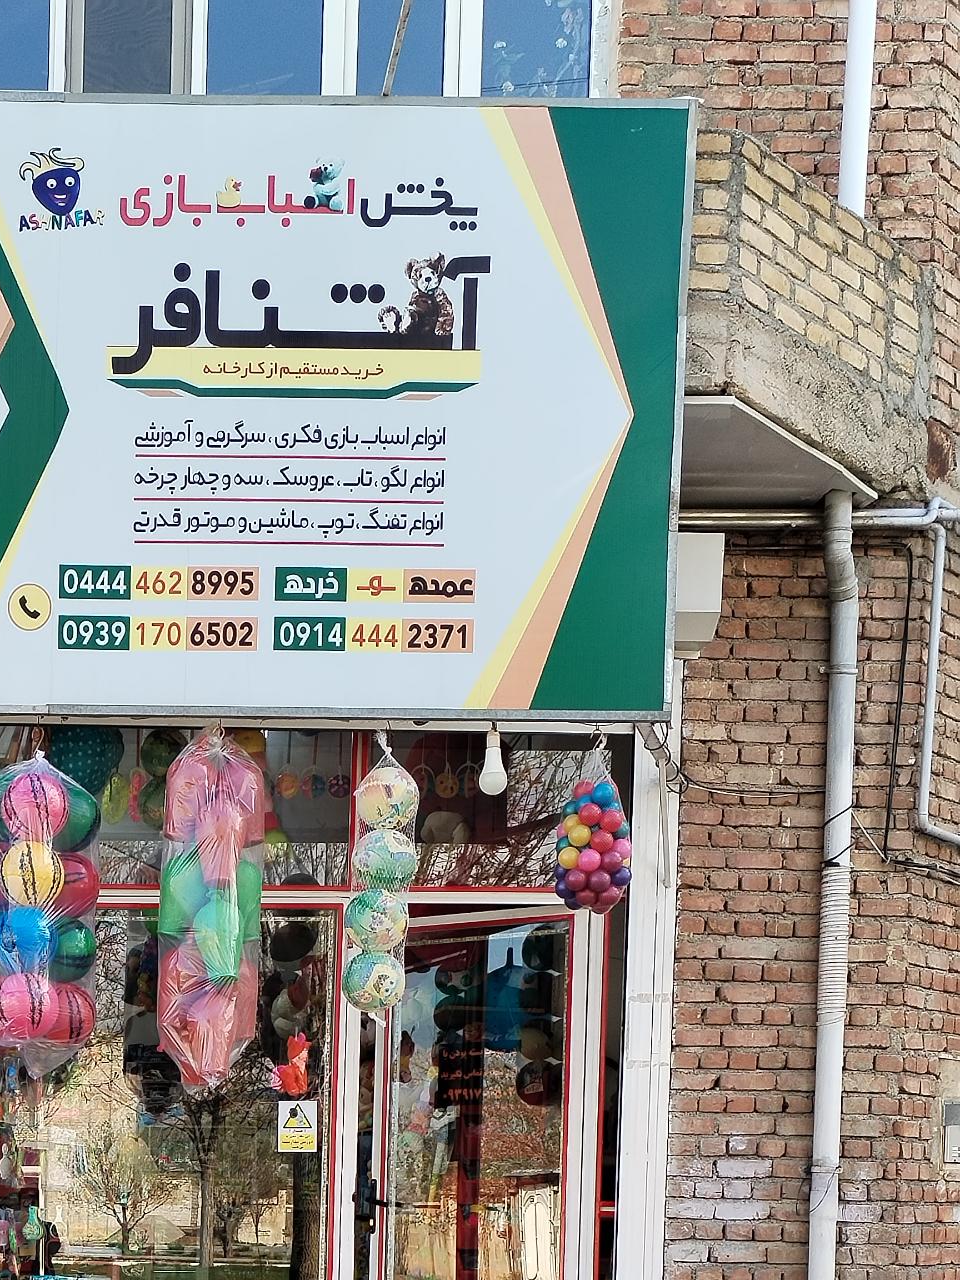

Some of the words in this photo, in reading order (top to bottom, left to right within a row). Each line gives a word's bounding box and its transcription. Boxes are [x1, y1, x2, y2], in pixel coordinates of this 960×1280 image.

[120, 175, 211, 227] بازی
[361, 177, 478, 231] پخش
[19, 210, 104, 232] ASHNAFAR
[202, 361, 265, 379] کارخانه
[265, 362, 278, 379] از
[279, 362, 339, 379] مستقیم
[341, 363, 384, 380] خرید
[134, 419, 194, 448] آموزشی
[194, 431, 204, 448] و
[206, 420, 266, 449] سرگرمی
[324, 425, 359, 450] بازی
[360, 425, 410, 451] اسباب
[410, 426, 447, 451] انواع
[134, 466, 178, 495] چرخه
[180, 466, 220, 495] چهار
[221, 474, 232, 491] و
[233, 472, 264, 486] سه
[409, 469, 445, 494] انواع
[133, 507, 182, 533] قدرتی
[183, 511, 236, 534] موتور
[238, 516, 248, 534] و
[248, 507, 309, 534] ماشین
[408, 511, 444, 536] انواع
[63, 569, 127, 595] 0444
[135, 570, 182, 595] 462
[191, 570, 254, 596] 8995
[283, 571, 339, 599] خرده
[408, 576, 474, 598] عمده
[62, 620, 126, 646] 0939
[135, 621, 182, 646] 170
[190, 621, 253, 647] 6502
[279, 621, 343, 647] 0914
[351, 623, 398, 648] 444
[407, 623, 468, 649] 2371
